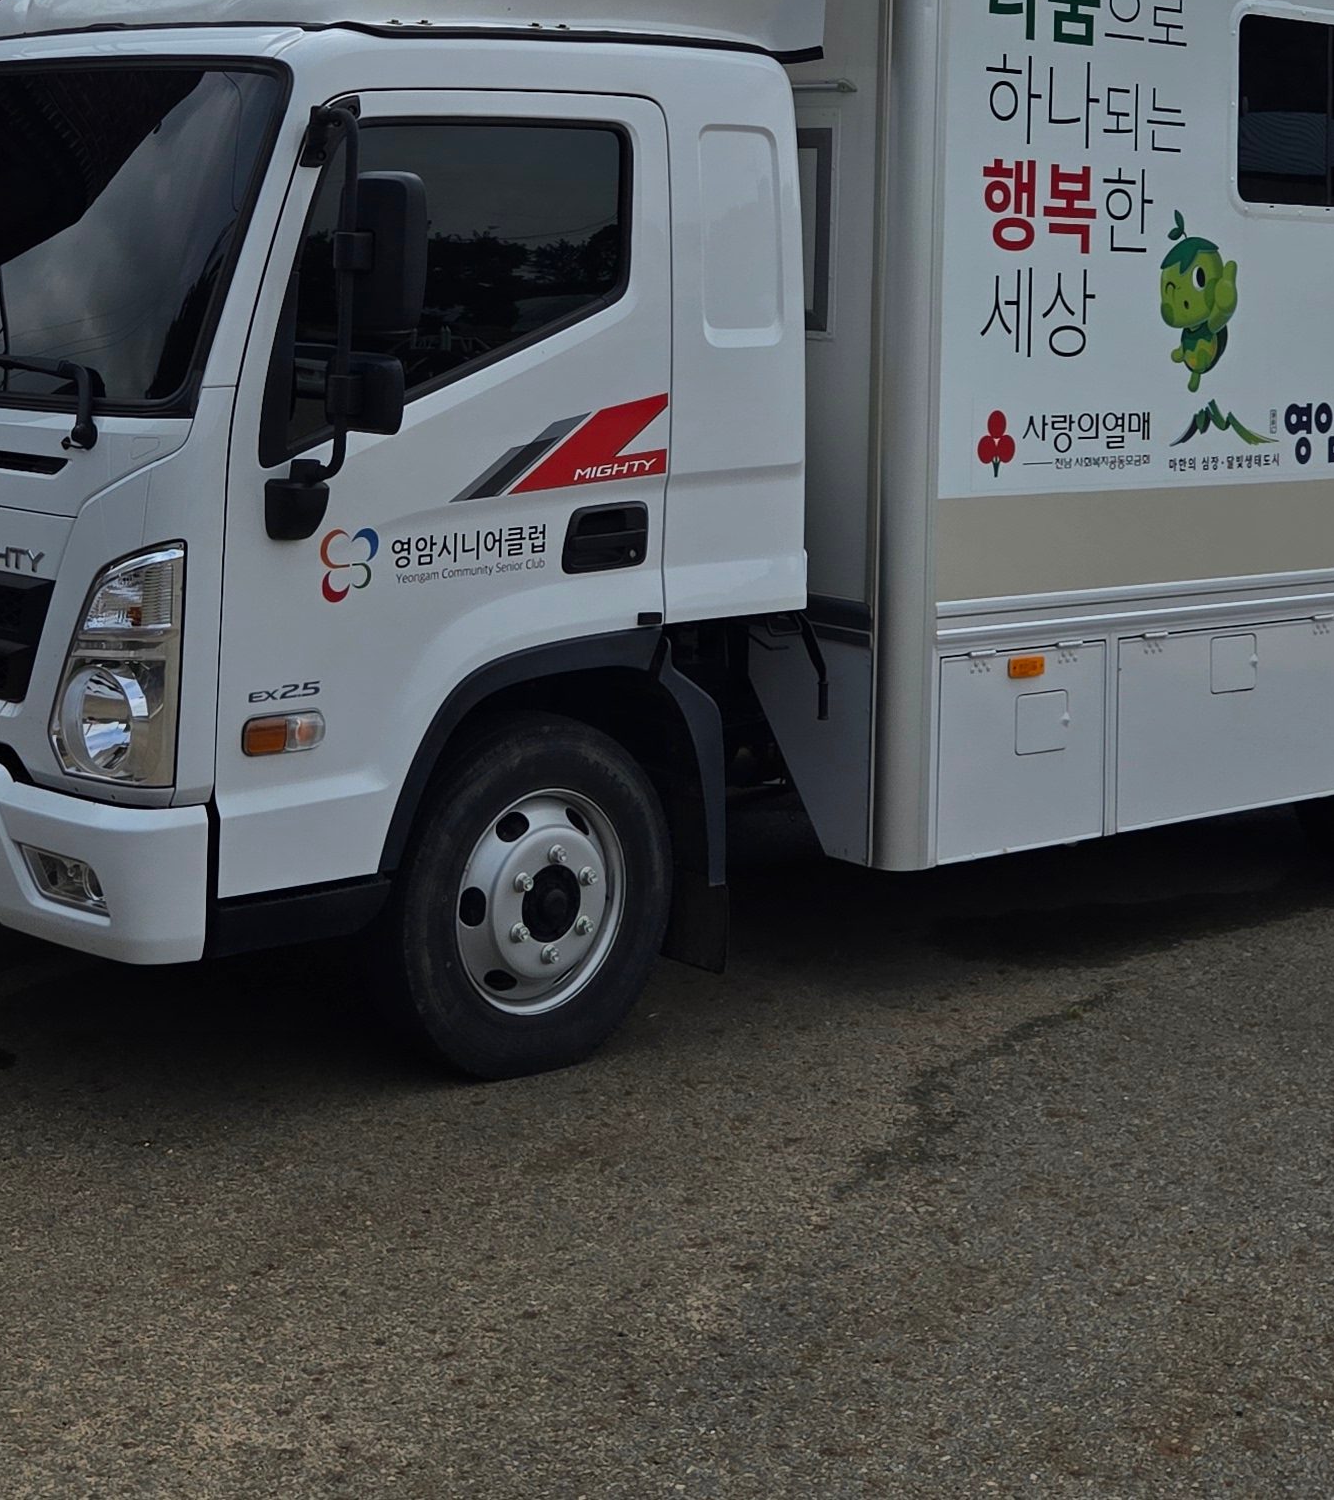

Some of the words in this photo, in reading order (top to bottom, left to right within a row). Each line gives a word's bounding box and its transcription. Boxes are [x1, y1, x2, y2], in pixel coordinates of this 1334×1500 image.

[985, 53, 1186, 153] 하나되는
[983, 158, 1154, 255] 행복한
[980, 266, 1096, 358] 세상
[1022, 411, 1151, 454] 사랑의열매
[573, 457, 658, 481] MIGHTY
[1054, 457, 1072, 469] 전남
[1074, 454, 1151, 470] 사회복지공동모금회
[1168, 456, 1196, 471] 마한의
[391, 524, 547, 569] 영암시니어클럽
[396, 570, 439, 584] Yeongam
[442, 565, 493, 579] Community
[495, 560, 523, 573] Senior
[525, 558, 546, 570] Club
